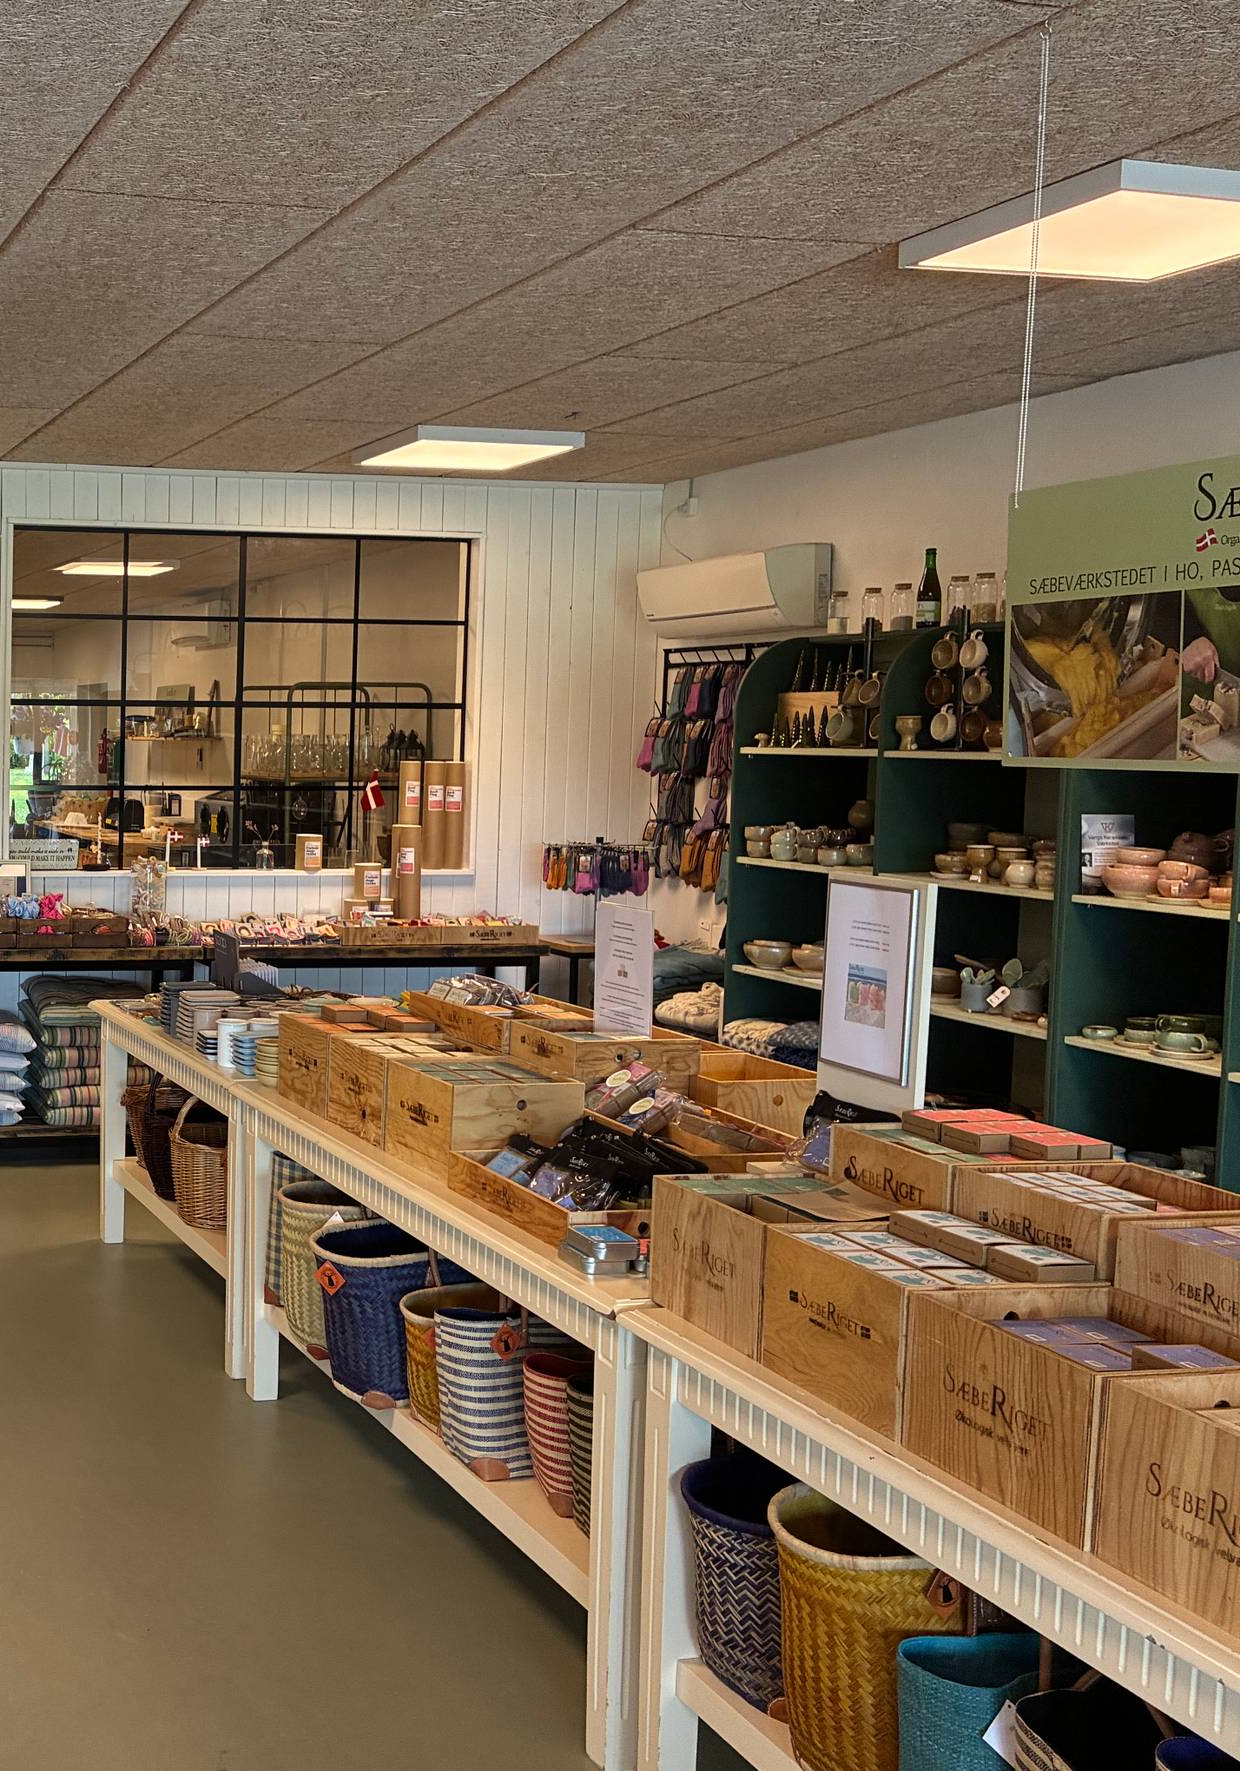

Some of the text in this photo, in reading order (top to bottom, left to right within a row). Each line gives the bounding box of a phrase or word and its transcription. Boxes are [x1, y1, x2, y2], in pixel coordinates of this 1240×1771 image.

[1029, 566, 1156, 595] SÆBEVÆRKSTEDET
[1164, 565, 1168, 582] I
[1175, 561, 1204, 582] HO,
